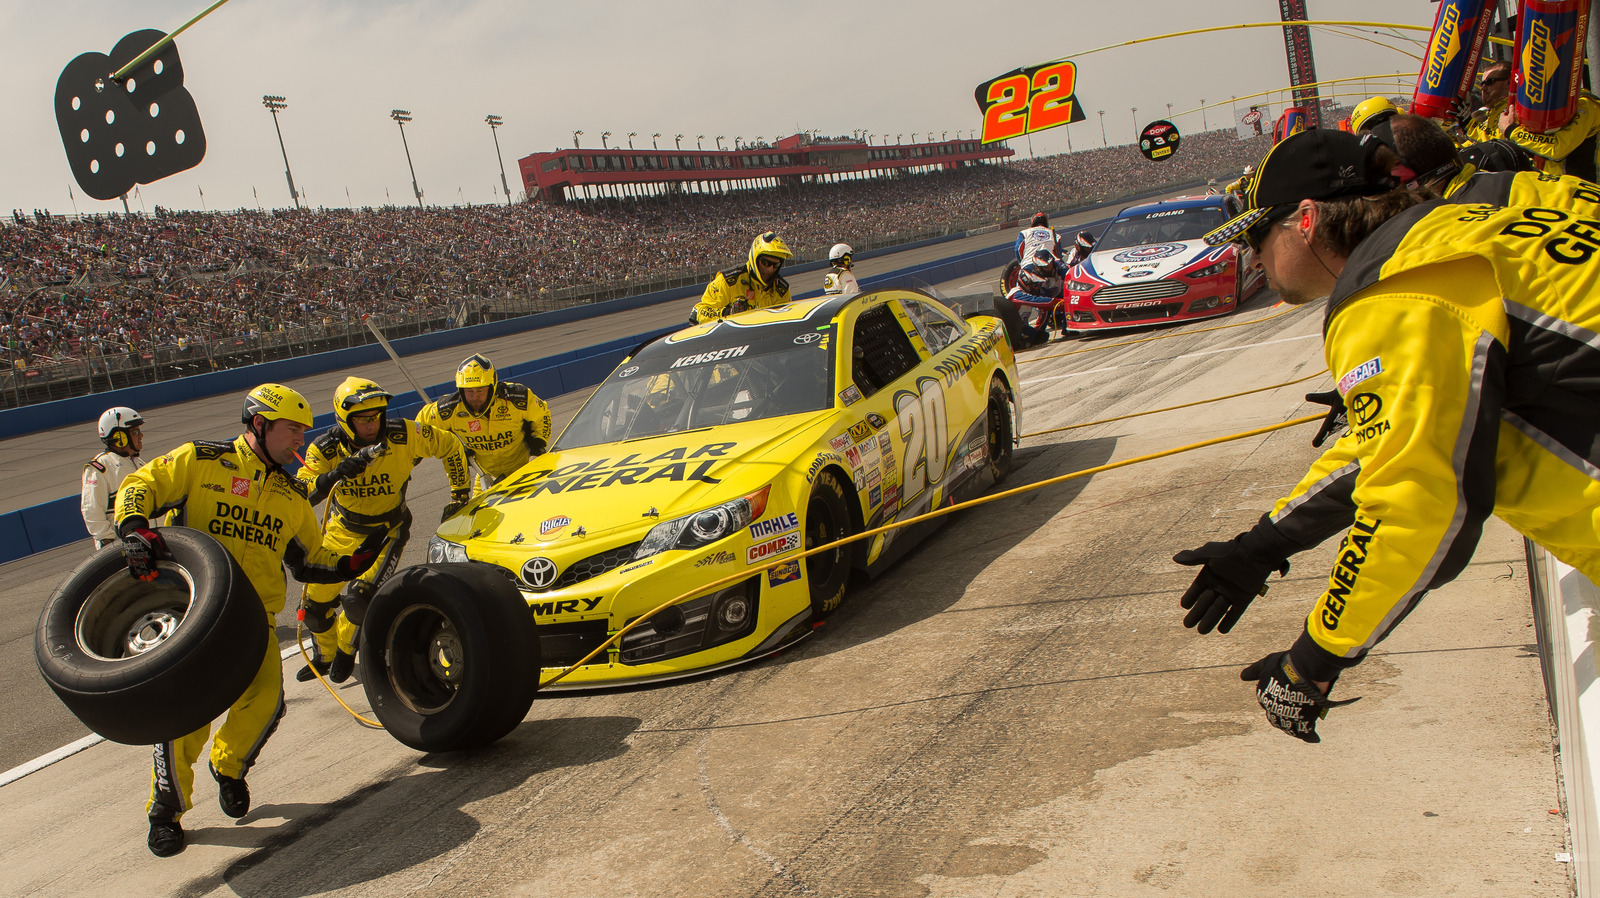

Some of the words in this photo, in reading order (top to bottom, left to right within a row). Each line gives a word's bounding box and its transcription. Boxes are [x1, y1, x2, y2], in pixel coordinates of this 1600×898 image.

[1428, 8, 1459, 85] SUNOCO
[1526, 23, 1550, 102] SUNOCO
[981, 60, 1076, 145] 22
[1150, 127, 1167, 135] DOW
[1154, 137, 1166, 145] 3
[1518, 131, 1555, 145] GENERAL
[1145, 209, 1184, 219] LOGANO
[1070, 295, 1080, 305] 22
[1115, 301, 1161, 310] FUSION
[669, 345, 750, 369] KENSETH
[933, 344, 983, 389] DOLLAR
[260, 386, 283, 402] DOLLAR
[465, 430, 513, 443] DOLLAR
[466, 439, 514, 451] GENERAL
[893, 376, 949, 507] 20
[447, 455, 457, 486] DOLLAR
[507, 441, 738, 487] DOLLAR
[806, 452, 842, 485] GOODYEAR
[476, 460, 722, 510] GENERAL
[216, 501, 284, 535] DOLLAR
[749, 512, 799, 539] MAHLE
[208, 518, 280, 552] GENERAL
[749, 537, 787, 560] COMP
[776, 544, 796, 554] CAMS
[770, 563, 798, 580] SUNOCO
[1321, 517, 1382, 631] GENERAL
[529, 596, 604, 616] MRY
[154, 742, 171, 793] ENERAL
